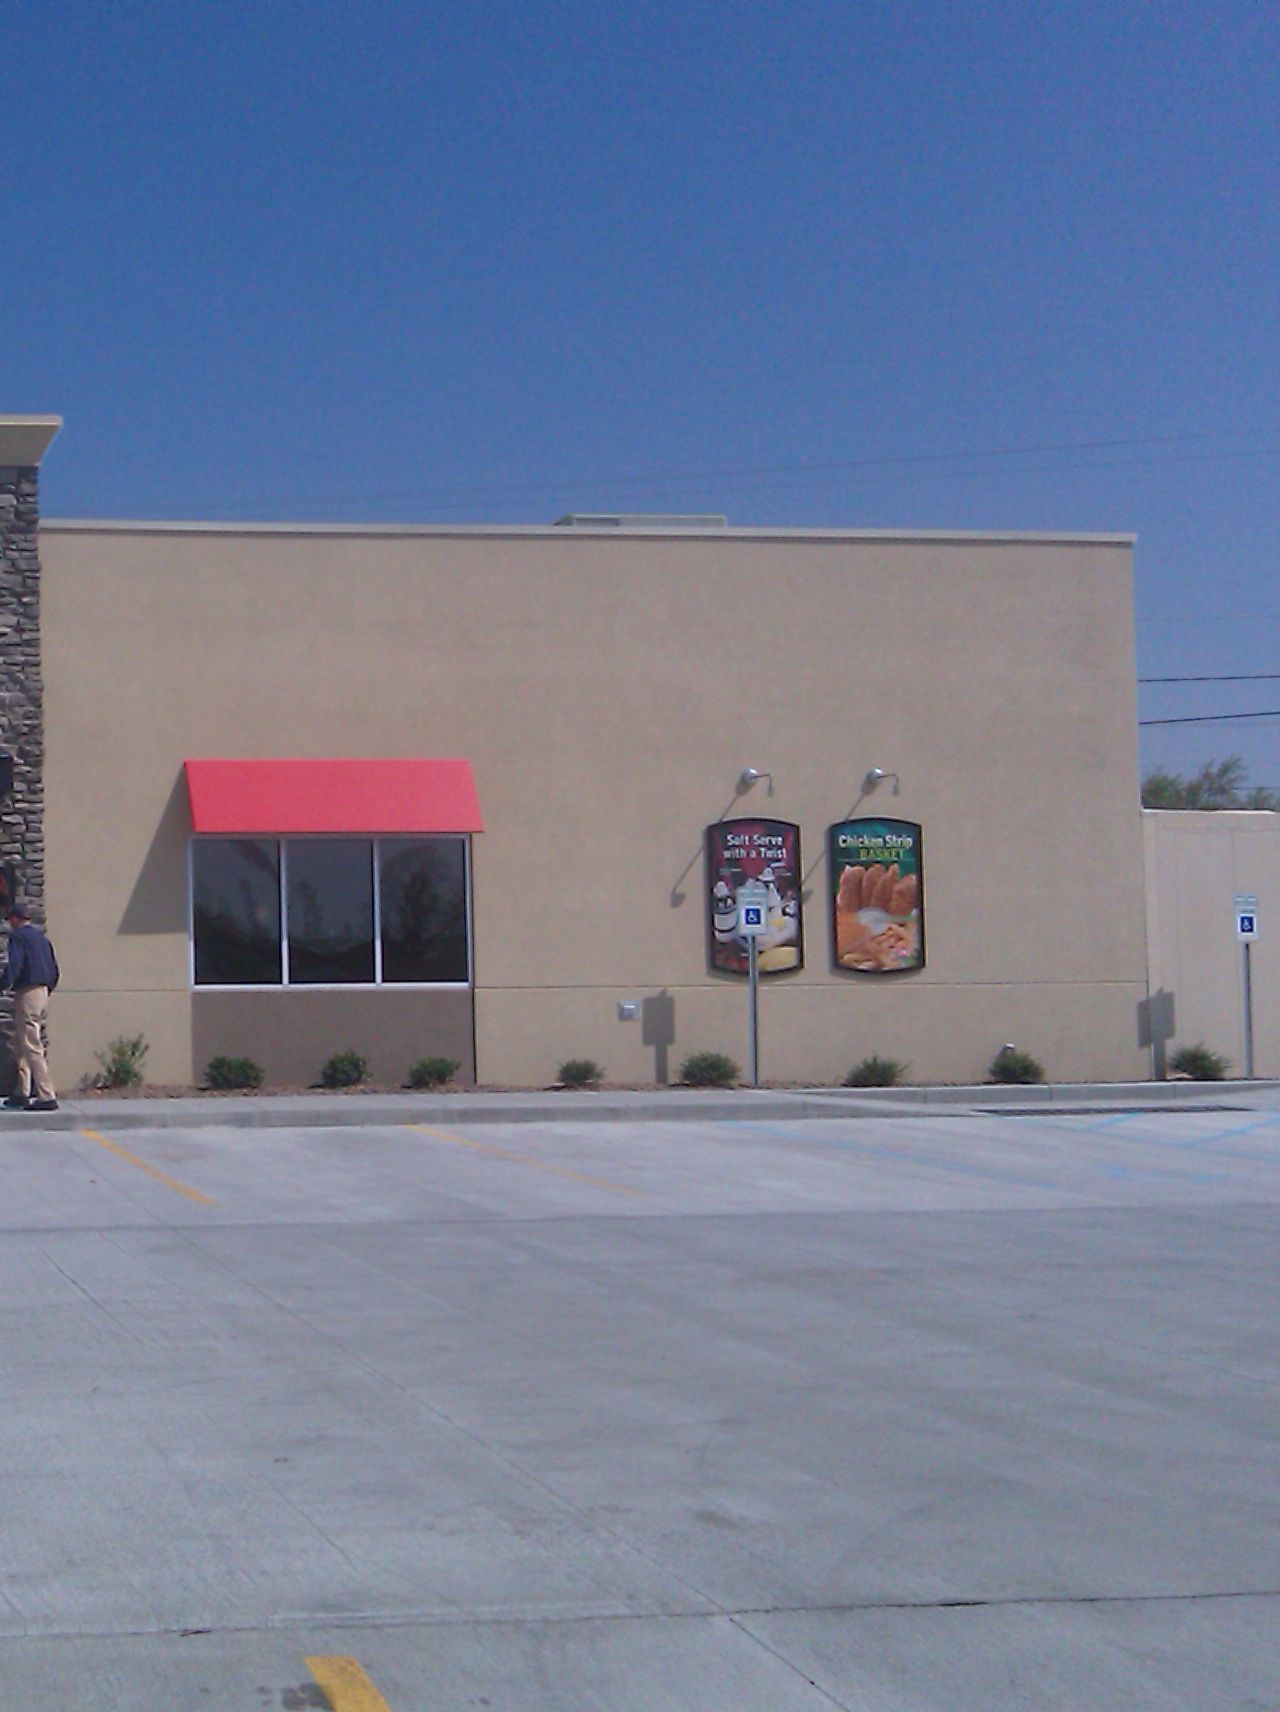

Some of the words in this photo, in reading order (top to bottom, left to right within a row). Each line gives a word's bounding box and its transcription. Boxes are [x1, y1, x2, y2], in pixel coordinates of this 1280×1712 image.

[726, 834, 750, 846] Soft
[753, 834, 784, 846] Serve
[838, 834, 883, 848] Chicken
[885, 834, 913, 849] Strip
[723, 847, 746, 859] with
[759, 847, 787, 859] Twist
[858, 848, 904, 860] BASKET
